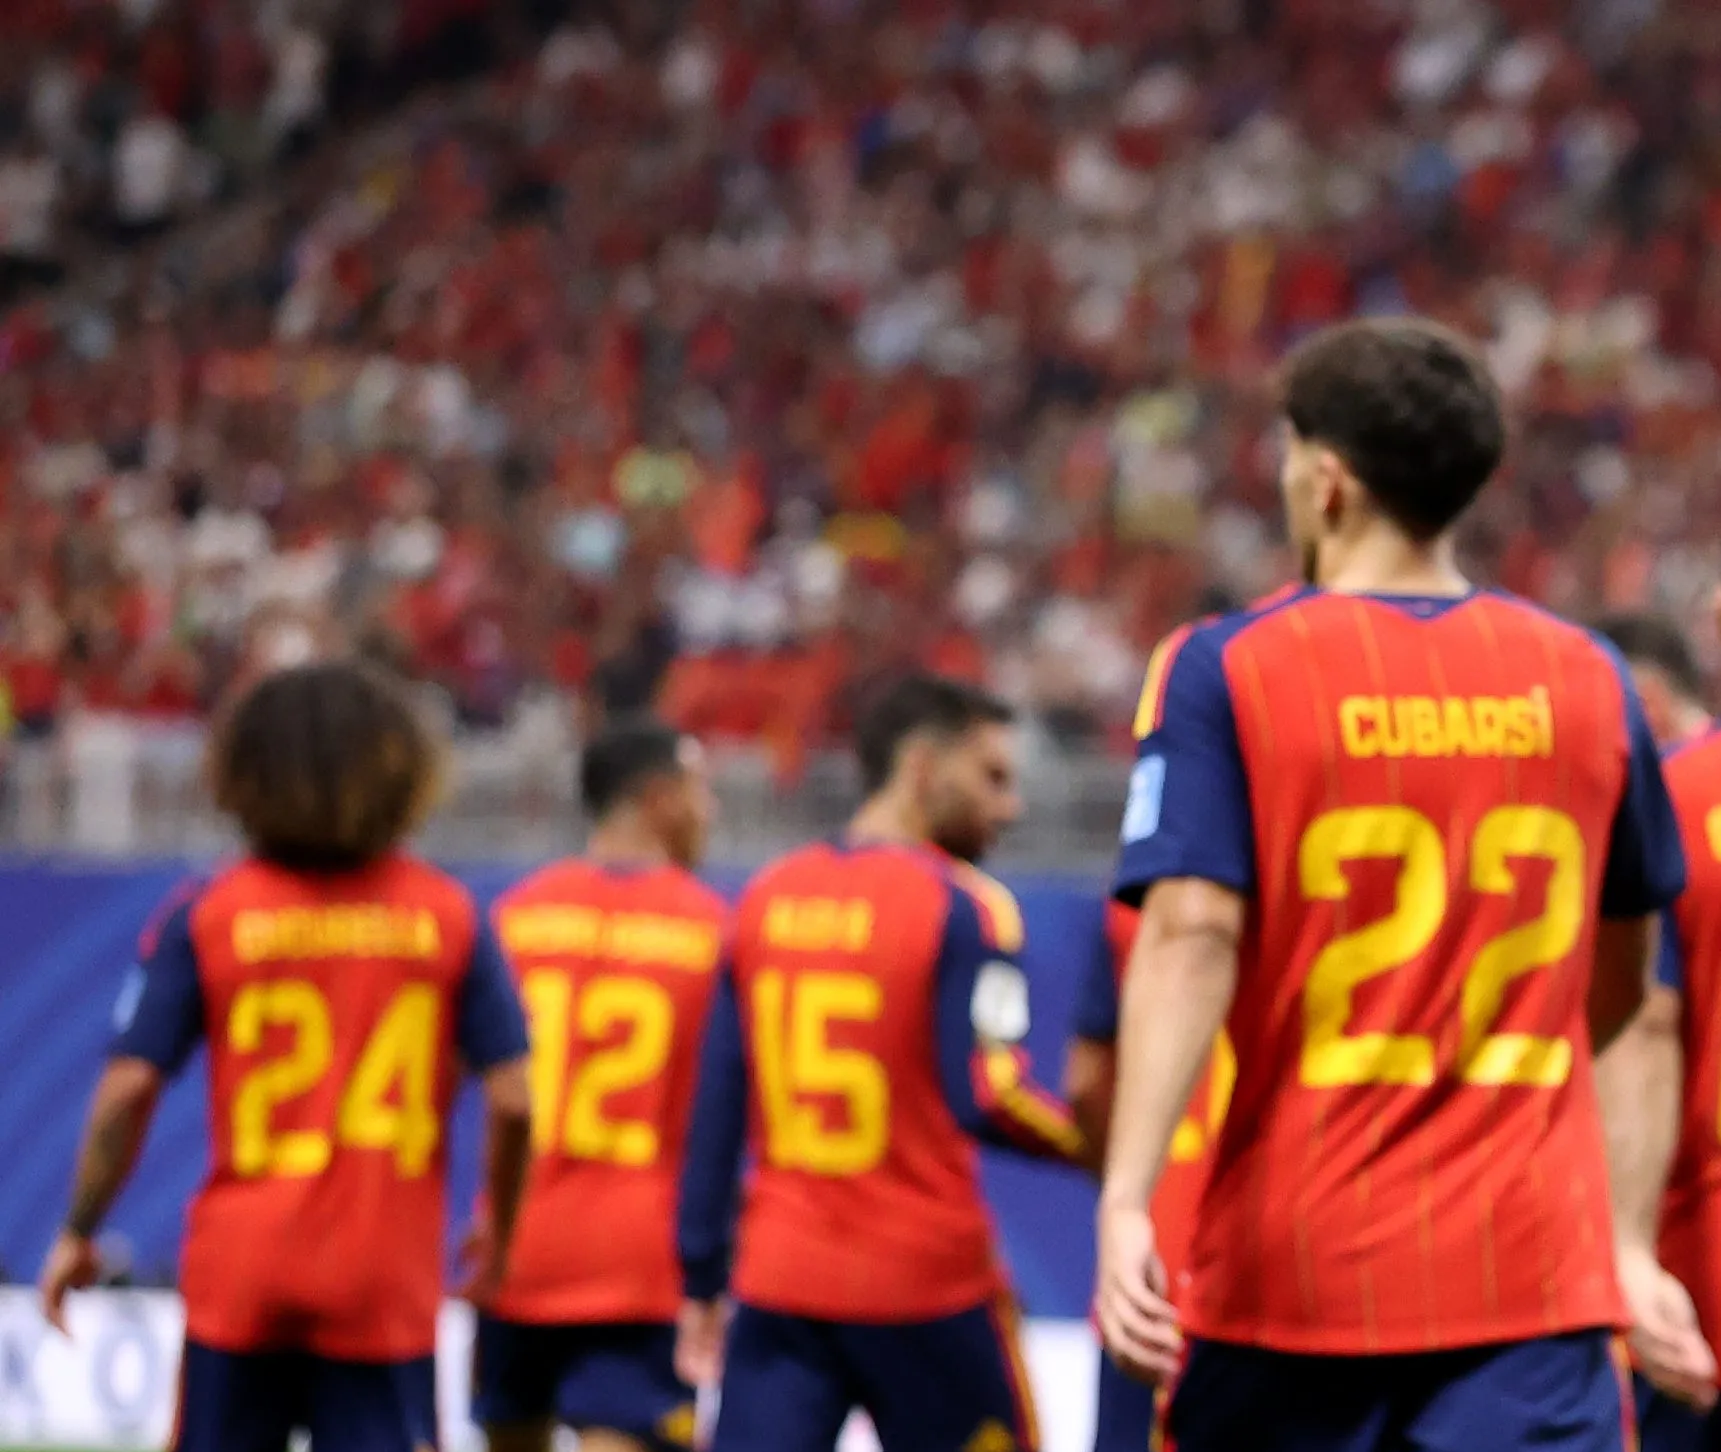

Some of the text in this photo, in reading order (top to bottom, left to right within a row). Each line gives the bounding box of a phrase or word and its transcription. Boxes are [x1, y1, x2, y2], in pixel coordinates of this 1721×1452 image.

[1338, 684, 1553, 758] CUBARSÍ
[1299, 804, 1587, 1088] 22
[229, 976, 442, 1178] 24
[522, 967, 675, 1166] 12
[752, 967, 890, 1176] 15
